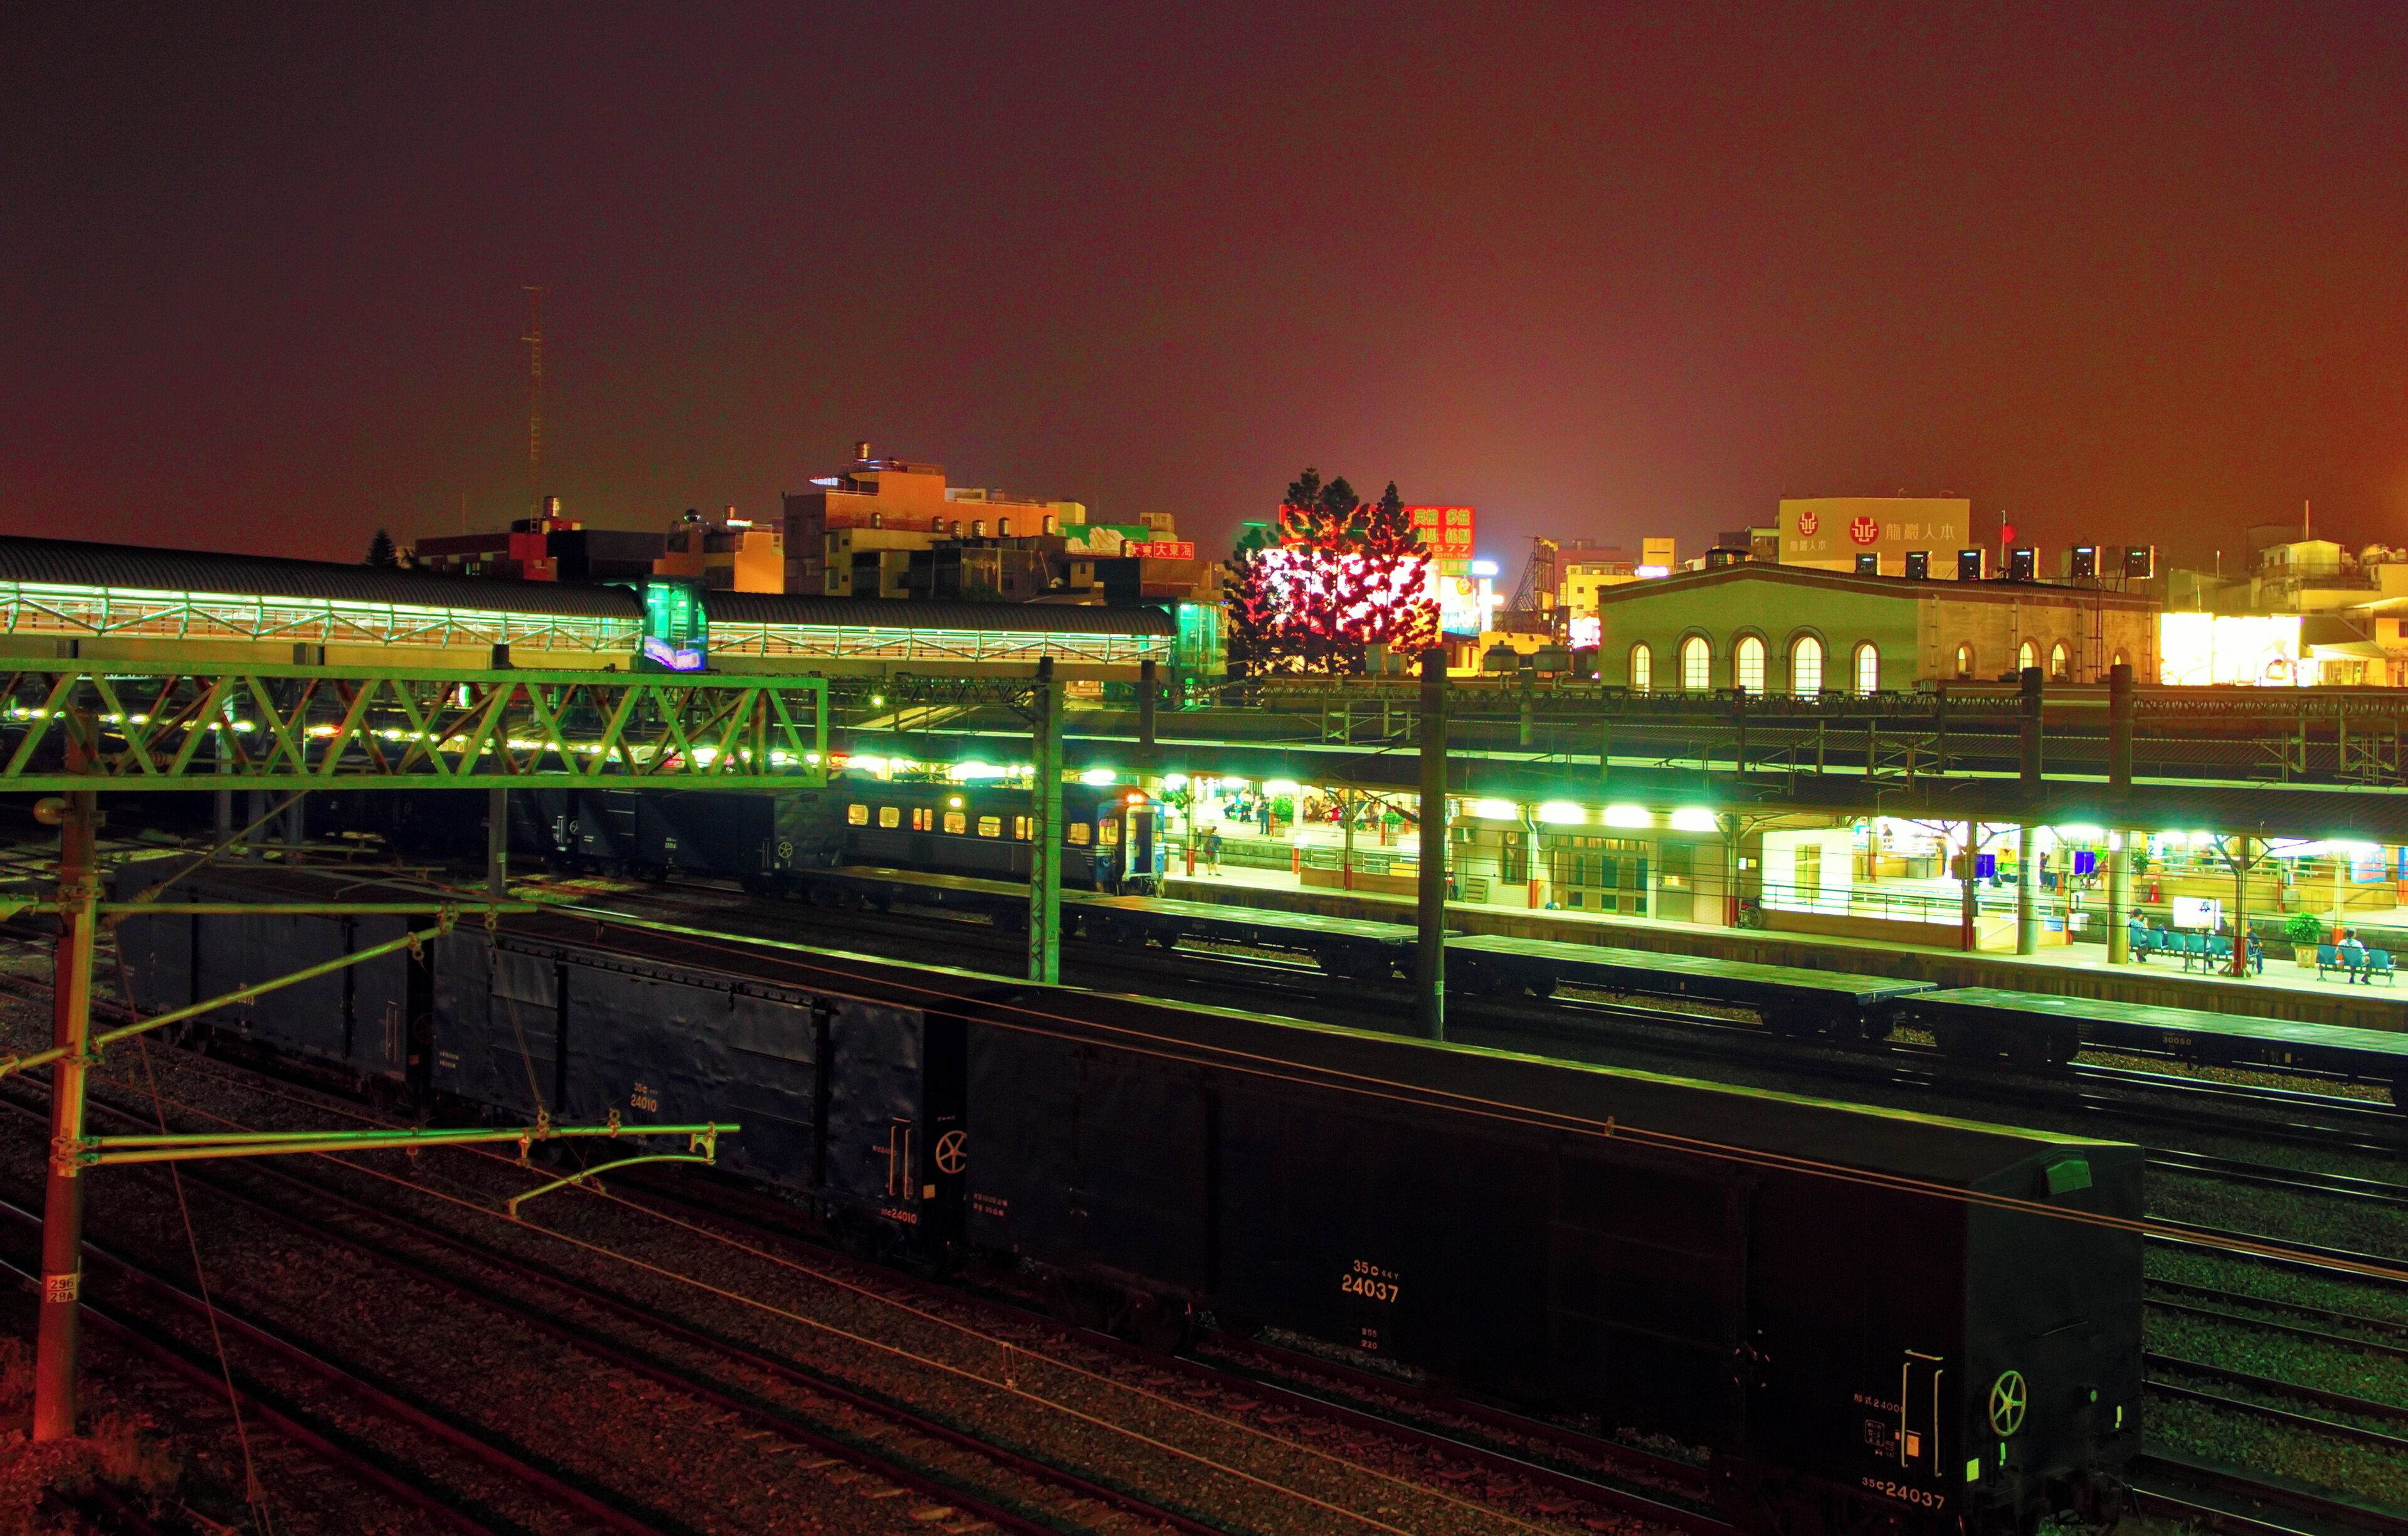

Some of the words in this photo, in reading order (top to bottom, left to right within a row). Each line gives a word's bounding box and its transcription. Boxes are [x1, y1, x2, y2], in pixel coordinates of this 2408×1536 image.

[1446, 509, 1470, 525] 多益
[1156, 543, 1191, 557] 大東海
[631, 1094, 657, 1113] 24010
[1353, 1259, 1379, 1276] 35C
[50, 1278, 73, 1289] 296
[1342, 1274, 1398, 1303] 24037
